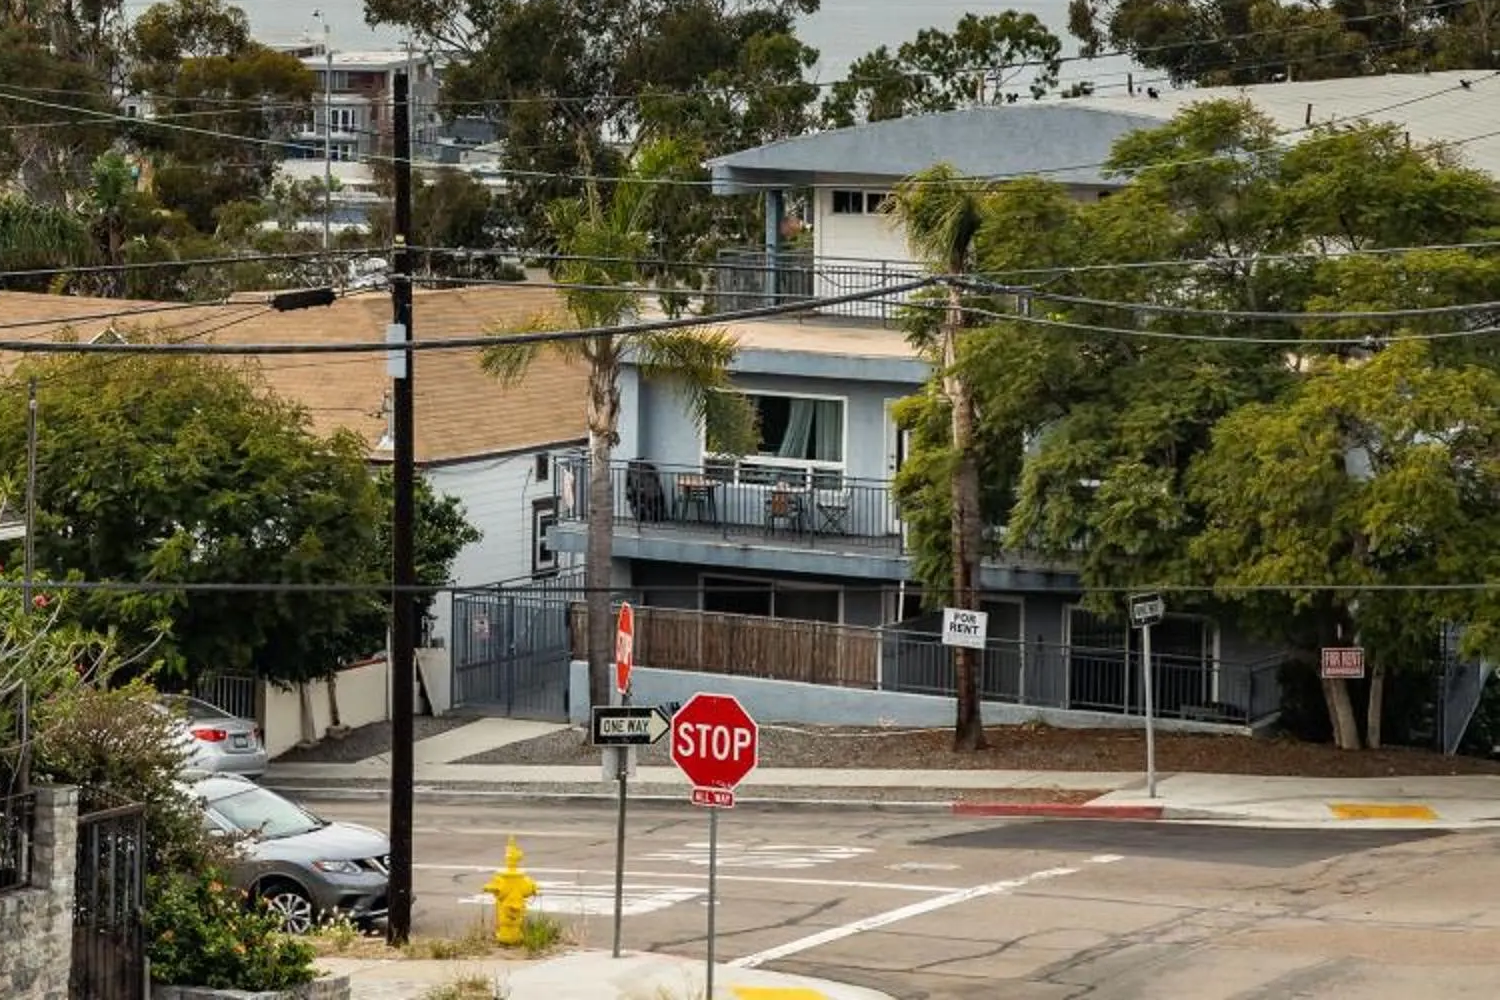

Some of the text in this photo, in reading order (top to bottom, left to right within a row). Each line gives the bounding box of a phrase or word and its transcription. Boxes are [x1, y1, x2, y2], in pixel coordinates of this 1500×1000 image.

[954, 612, 977, 624] FOR
[949, 621, 980, 635] RENT
[603, 719, 649, 733] ONE WAY
[677, 721, 751, 761] STOP
